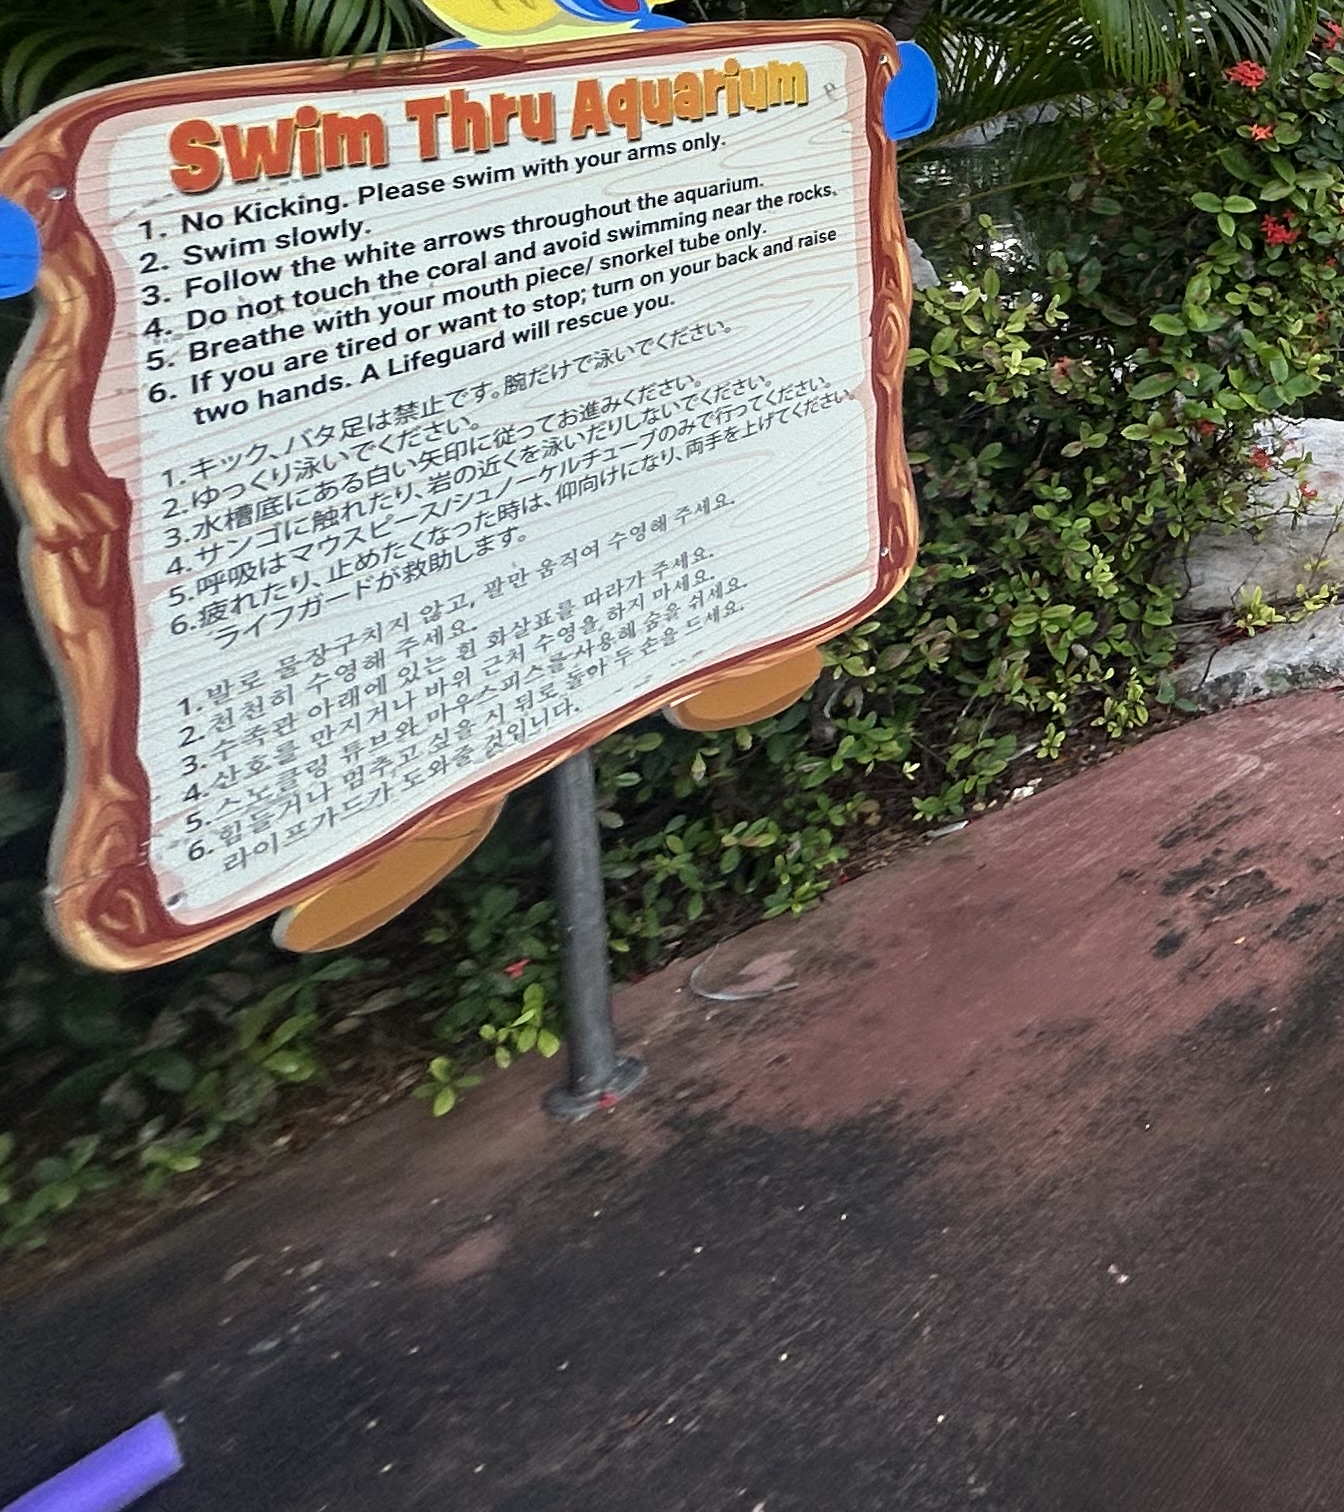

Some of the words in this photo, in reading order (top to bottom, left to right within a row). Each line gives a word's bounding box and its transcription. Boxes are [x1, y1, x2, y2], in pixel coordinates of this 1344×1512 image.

[137, 219, 167, 240] 1.
[180, 211, 223, 234] No
[233, 194, 349, 226] Kicking.
[357, 178, 446, 205] Please
[451, 165, 515, 189] swim
[521, 154, 569, 178] with
[574, 149, 622, 174] your
[626, 141, 677, 161] arms
[681, 131, 726, 152] only.
[168, 104, 389, 196] Swim
[404, 87, 556, 163] Thru
[570, 57, 809, 143] Aquarium
[138, 251, 170, 274] 2.
[182, 236, 266, 265] Swim
[274, 217, 371, 249] slowly.
[141, 284, 171, 306] 3.
[184, 265, 283, 299] Follow
[289, 254, 336, 277] the
[343, 240, 416, 267] white
[422, 224, 505, 252] arrows
[509, 197, 632, 235] throughout
[635, 191, 668, 211] the
[673, 175, 764, 204] aquarium.
[142, 316, 172, 338] 4.
[186, 308, 227, 330] Do
[236, 293, 286, 320] not
[290, 275, 370, 308] touch
[376, 268, 420, 290] the
[426, 250, 487, 280] coral
[493, 240, 536, 266] and
[542, 227, 601, 256] avoid
[605, 210, 707, 243] swimming
[711, 201, 752, 221] near
[755, 193, 783, 211] the
[787, 183, 837, 205] rocks.
[145, 348, 175, 371] 5.
[188, 323, 305, 362] Breathe
[312, 305, 370, 334] with
[376, 294, 436, 325] your
[442, 272, 518, 306] mouth
[525, 255, 594, 292] piece/
[598, 238, 673, 270] snorkel
[678, 231, 720, 252] tube
[724, 221, 767, 242] only.
[148, 381, 177, 403] 6.
[189, 368, 213, 394] If
[219, 360, 274, 392] you
[283, 348, 328, 372] are
[334, 326, 397, 359] tired
[404, 323, 432, 343] or
[436, 306, 497, 335] want
[501, 302, 526, 319] to
[531, 287, 586, 312] stop;
[591, 276, 634, 298] turn
[639, 270, 664, 287] on
[668, 258, 711, 284] your
[715, 244, 758, 269] back
[762, 235, 793, 257] and
[797, 229, 837, 248] raise
[192, 399, 249, 425] two
[257, 372, 352, 410] hands.
[359, 362, 381, 384] A
[387, 329, 505, 377] Lifeguard
[511, 318, 550, 344] will
[556, 304, 628, 334] rescue
[632, 294, 675, 319] you.
